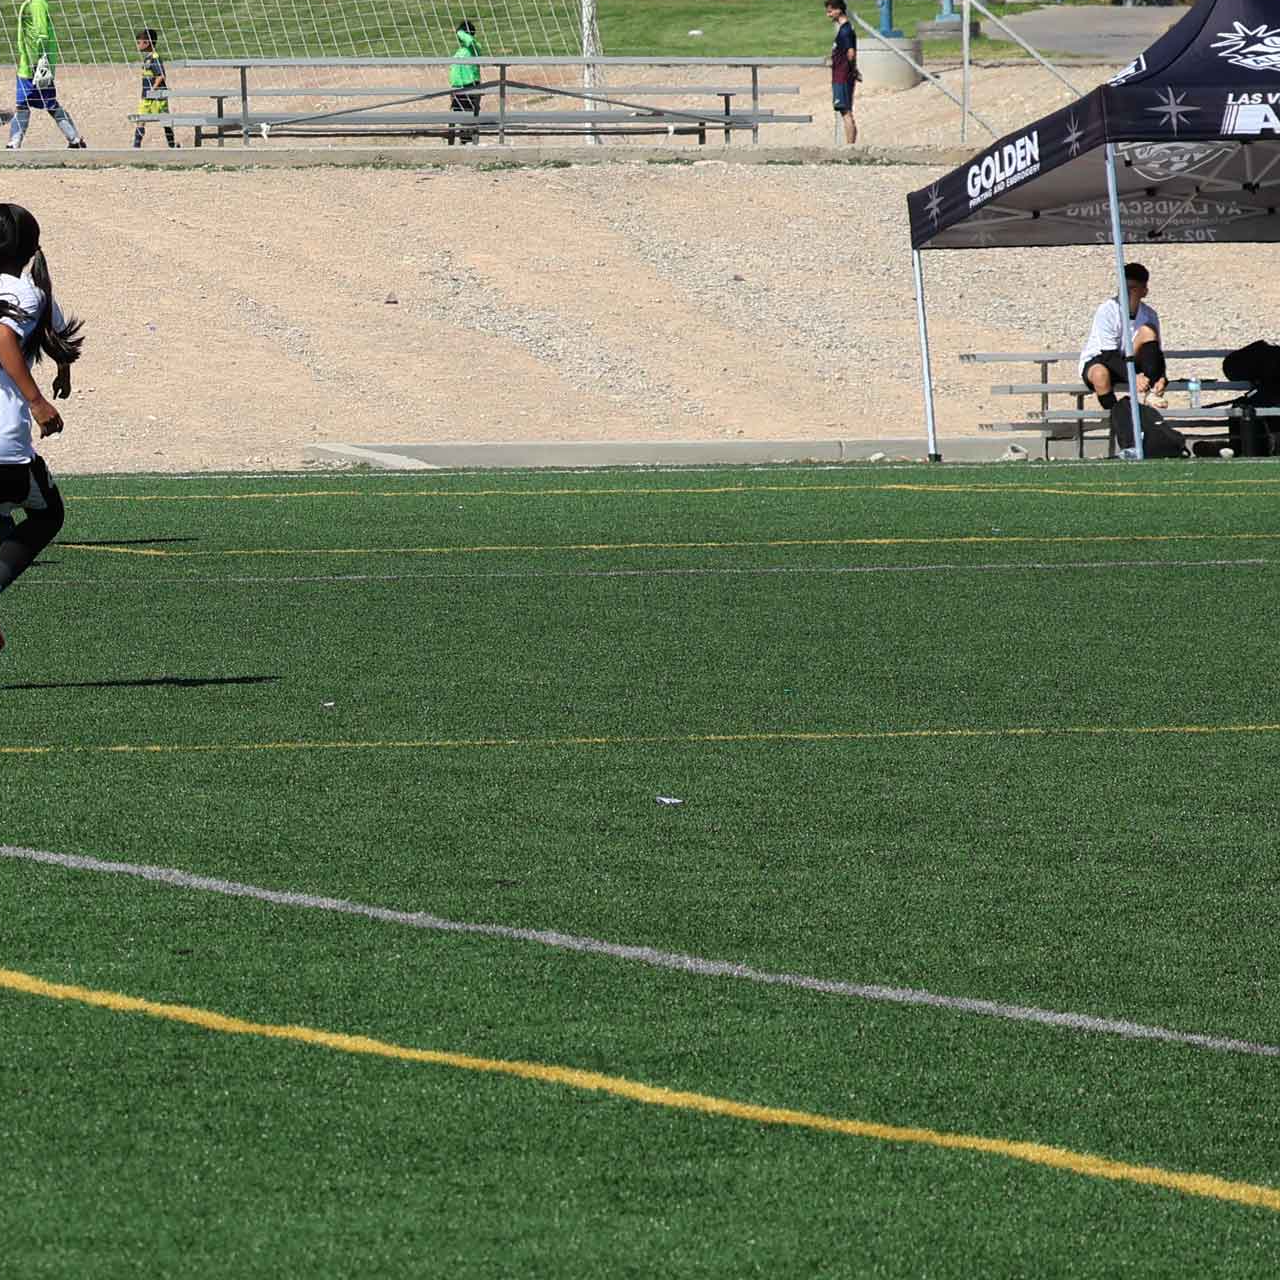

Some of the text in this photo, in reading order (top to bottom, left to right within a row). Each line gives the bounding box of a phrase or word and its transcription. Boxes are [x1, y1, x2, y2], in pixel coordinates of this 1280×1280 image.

[1226, 92, 1280, 105] LAS V
[967, 130, 1040, 198] GOLDEN
